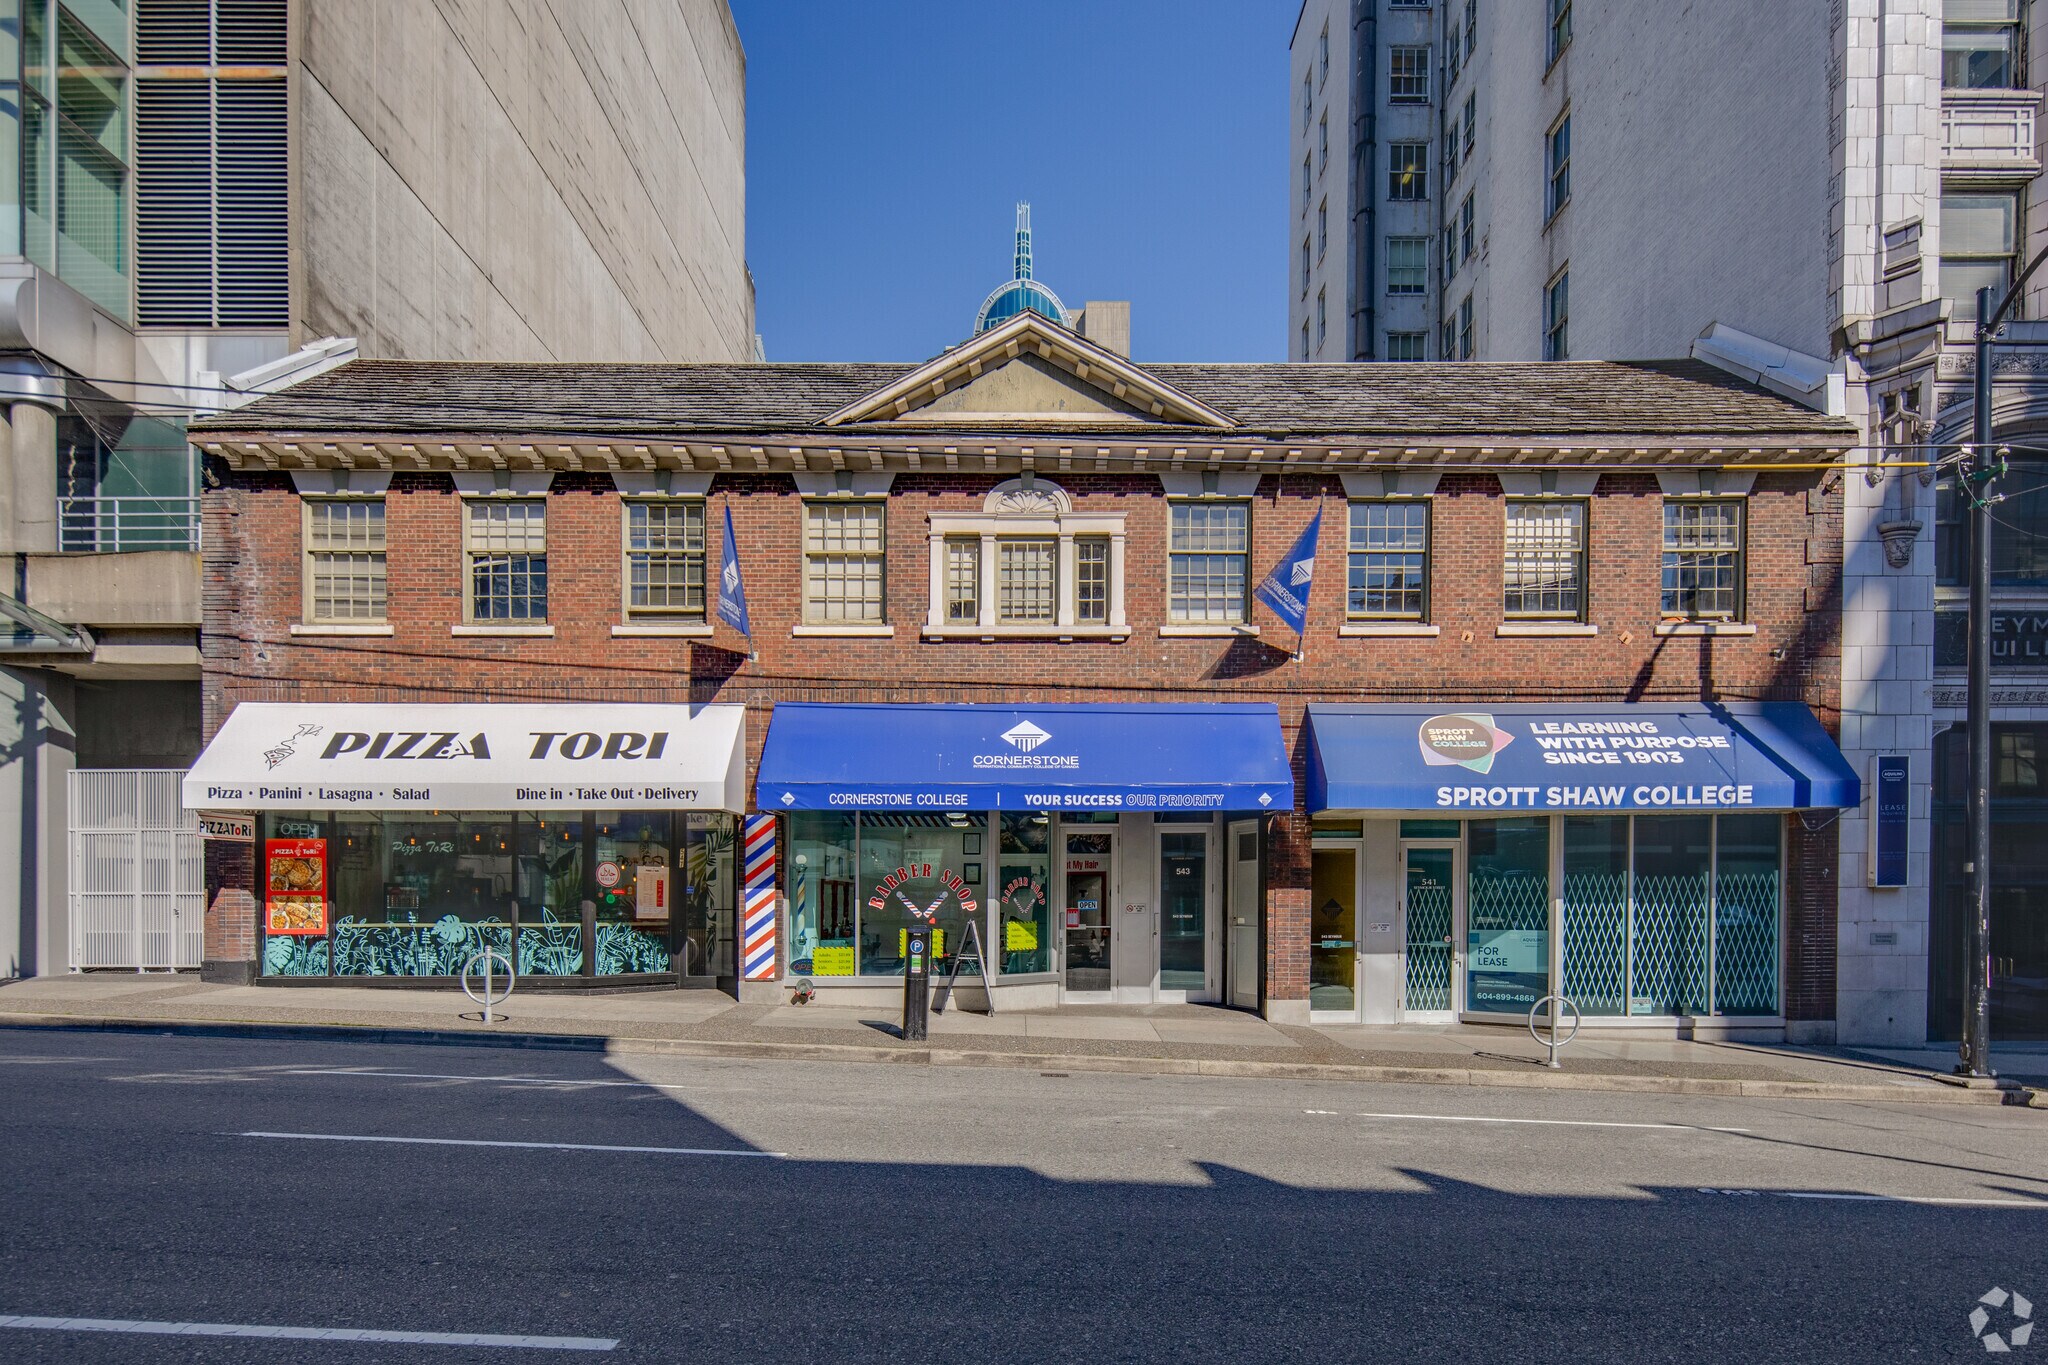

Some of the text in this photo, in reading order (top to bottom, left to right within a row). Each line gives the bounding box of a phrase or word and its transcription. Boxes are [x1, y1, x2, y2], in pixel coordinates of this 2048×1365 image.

[1264, 575, 1306, 615] CORNERSTONE
[1529, 721, 1658, 735] LEARNING
[319, 732, 669, 760] PIZZA TORI
[1535, 735, 1730, 750] WITH PURPOSE
[973, 755, 1079, 765] CORNERSTONE
[1545, 751, 1684, 764] SINCE 1903
[208, 786, 430, 802] Pizza Panini Lasagna Salad
[516, 787, 699, 802] Dine in Take Out Delivery
[828, 793, 968, 806] CORNERSTONE COLLEGE
[1024, 794, 1225, 806] YOUR SUCCESS OUR PRIORITY
[1437, 785, 1753, 806] SPROTT SHAW COLLEGE
[281, 823, 316, 835] OPEN
[392, 841, 455, 855] Pizza ToRi
[1073, 861, 1083, 870] My
[1085, 860, 1099, 869] Hair
[1176, 867, 1191, 875] 543
[868, 863, 977, 912] BARBER SHOP
[1421, 878, 1437, 886] 541
[1001, 877, 1046, 906] BARBER SHOP
[1079, 901, 1096, 909] OPEN
[1478, 946, 1499, 956] FOR
[1477, 957, 1508, 967] LEASE
[1476, 992, 1535, 1002] 604-899-4868
